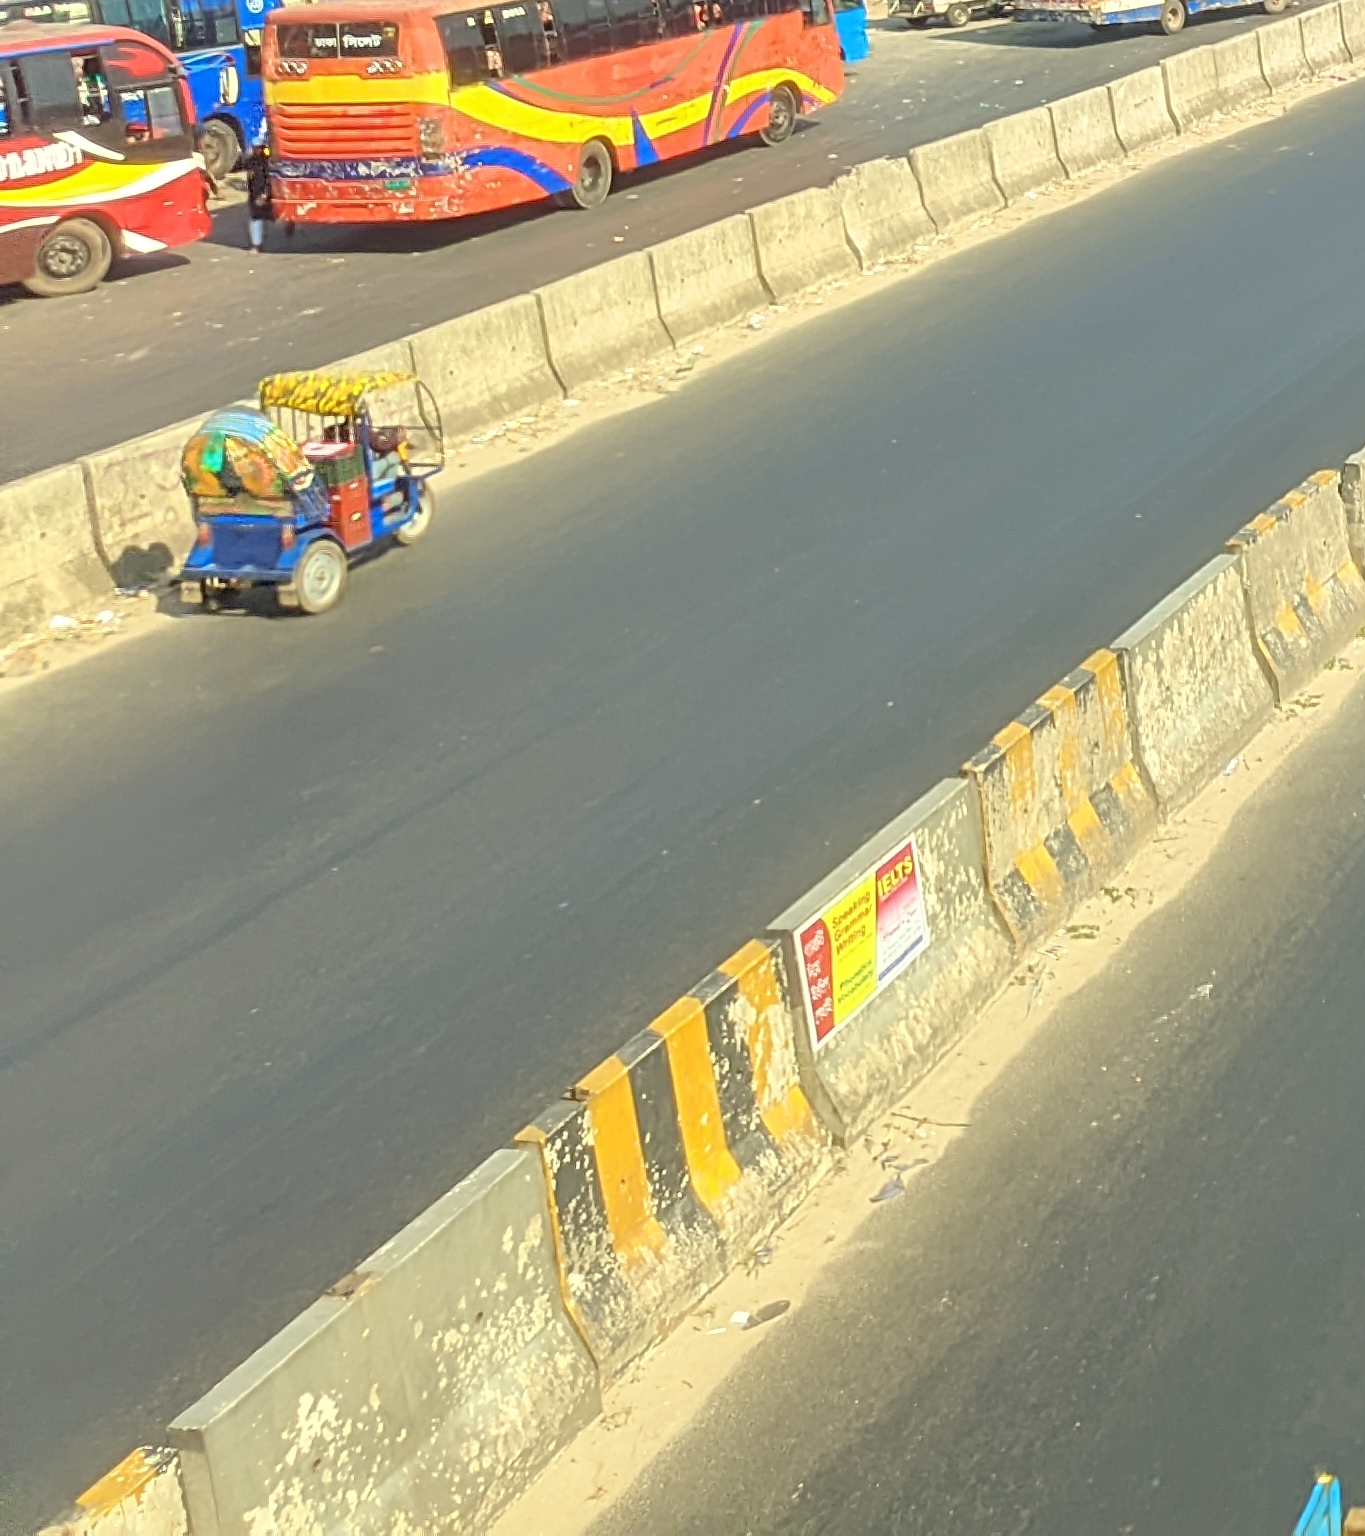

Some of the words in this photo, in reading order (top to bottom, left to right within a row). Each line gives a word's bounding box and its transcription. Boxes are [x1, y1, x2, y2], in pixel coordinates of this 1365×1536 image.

[877, 855, 913, 897] IELTS
[832, 891, 871, 930] Speaking
[834, 904, 873, 942] Grammar
[836, 924, 866, 956] Writing
